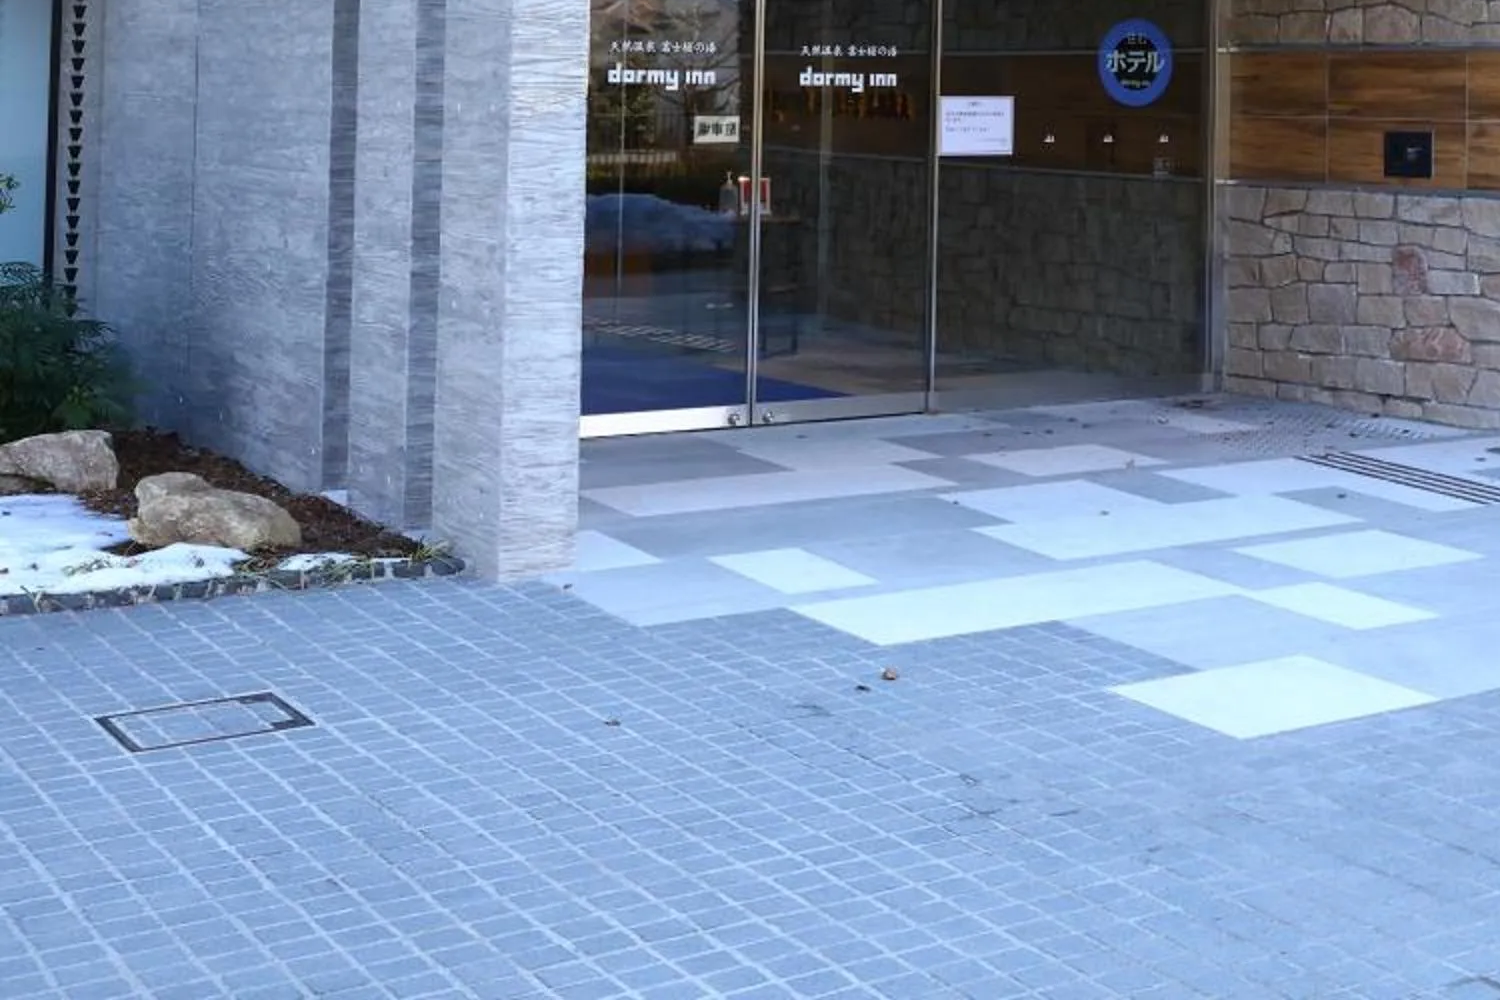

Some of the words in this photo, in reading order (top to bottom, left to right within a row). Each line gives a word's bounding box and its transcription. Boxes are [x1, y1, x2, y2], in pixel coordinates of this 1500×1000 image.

[1106, 49, 1165, 73] ホテル
[607, 62, 679, 91] dormy
[685, 70, 716, 84] inn
[799, 65, 865, 93] dormy
[869, 73, 897, 87] inn
